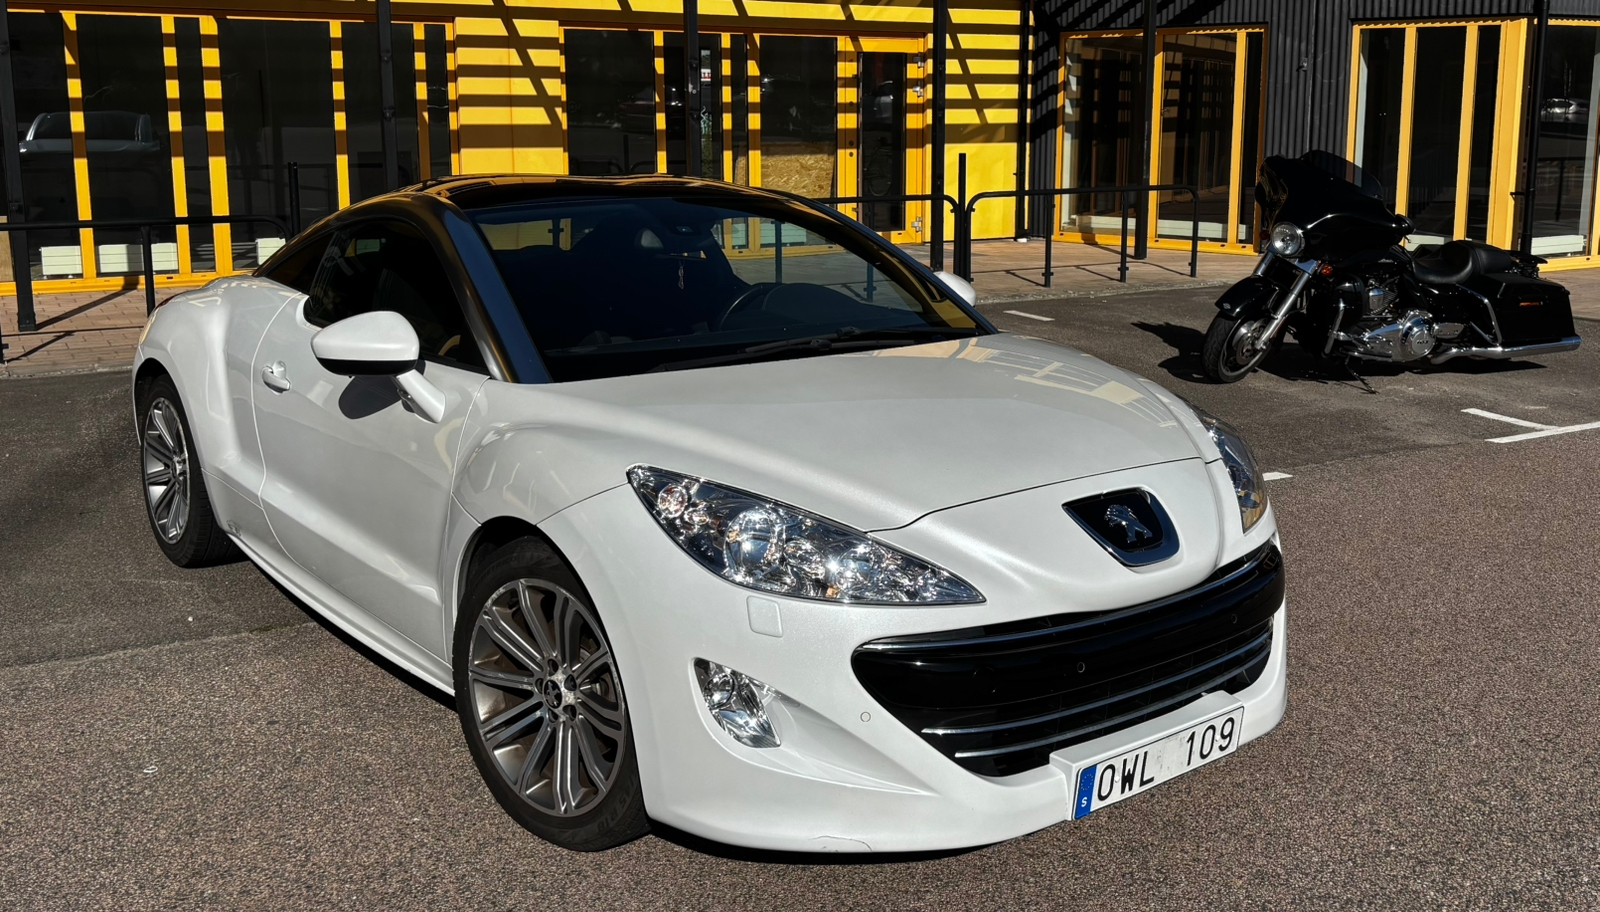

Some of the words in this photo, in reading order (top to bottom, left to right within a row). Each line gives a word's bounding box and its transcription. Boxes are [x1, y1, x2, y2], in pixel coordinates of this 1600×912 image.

[1097, 751, 1155, 801] OWL
[1186, 717, 1235, 766] 109
[1081, 796, 1088, 808] S
